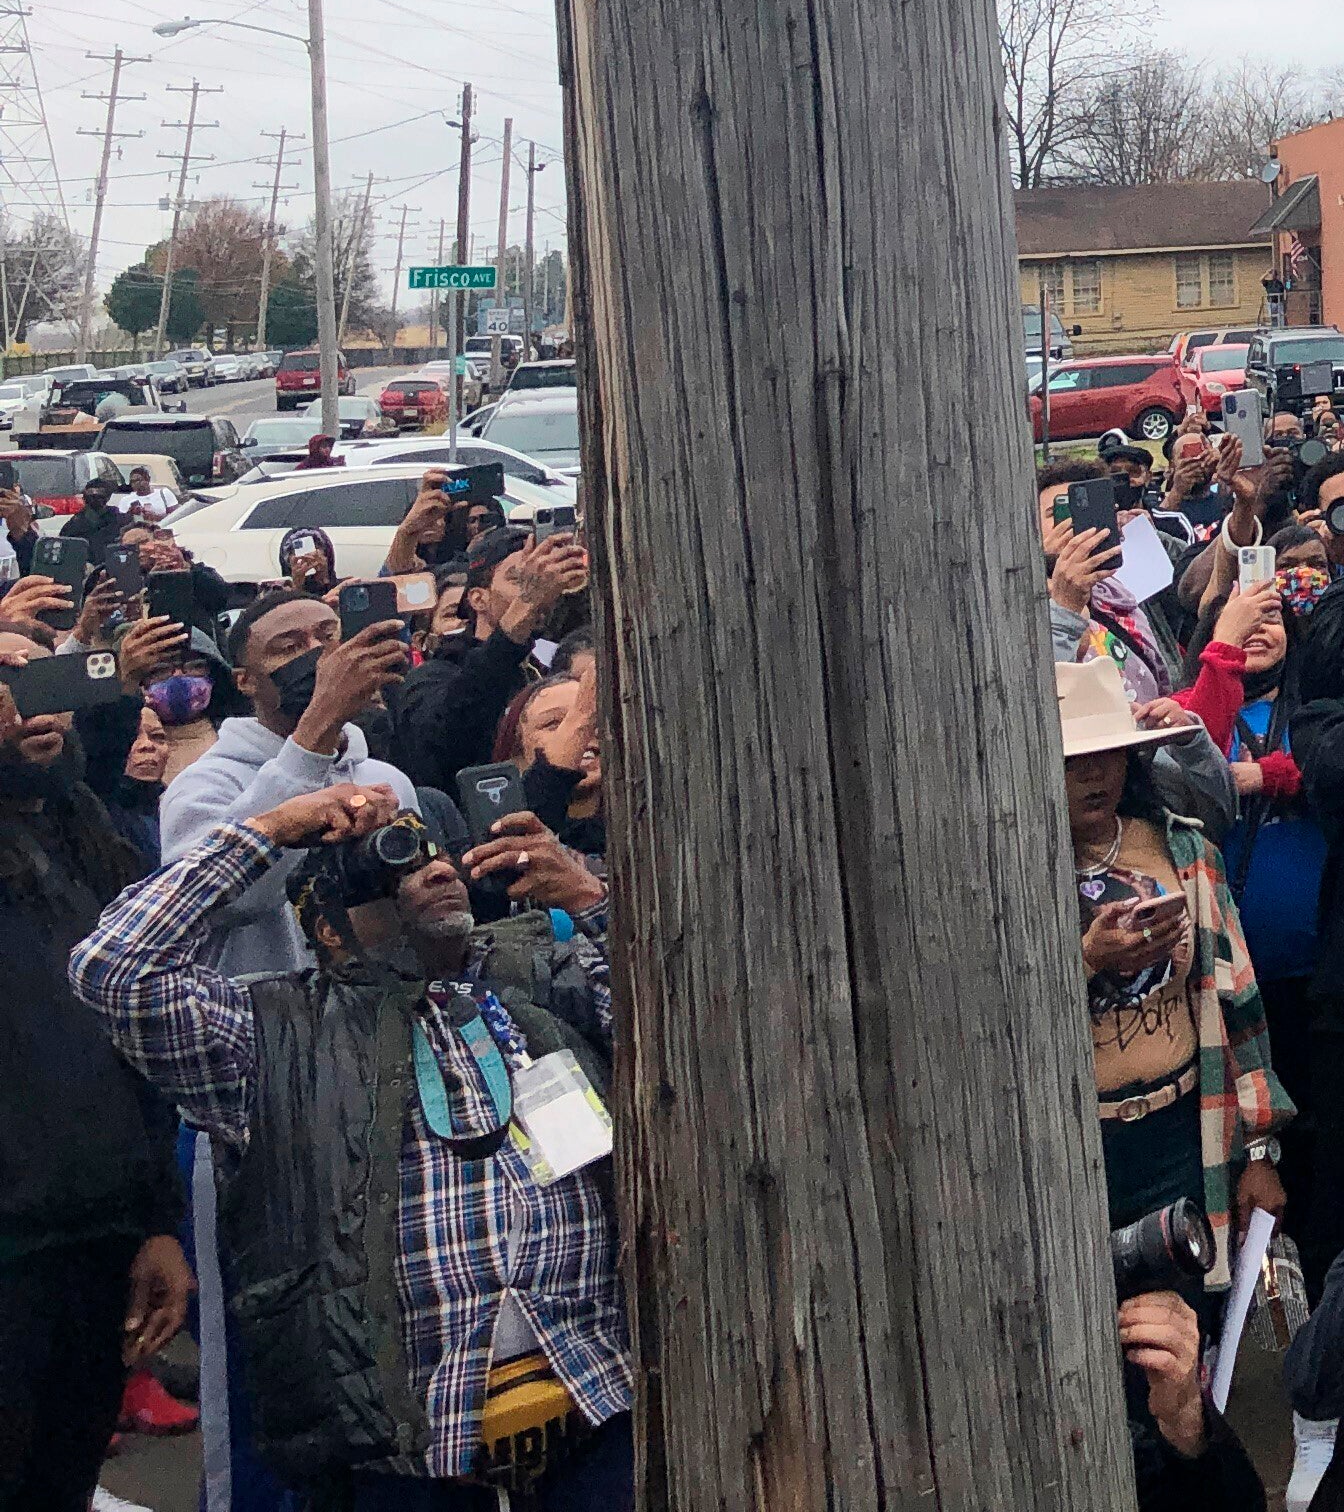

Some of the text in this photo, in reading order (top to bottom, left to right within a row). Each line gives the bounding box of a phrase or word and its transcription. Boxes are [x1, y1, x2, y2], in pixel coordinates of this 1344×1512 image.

[412, 269, 492, 287] Frisco AVE
[488, 321, 508, 332] 40
